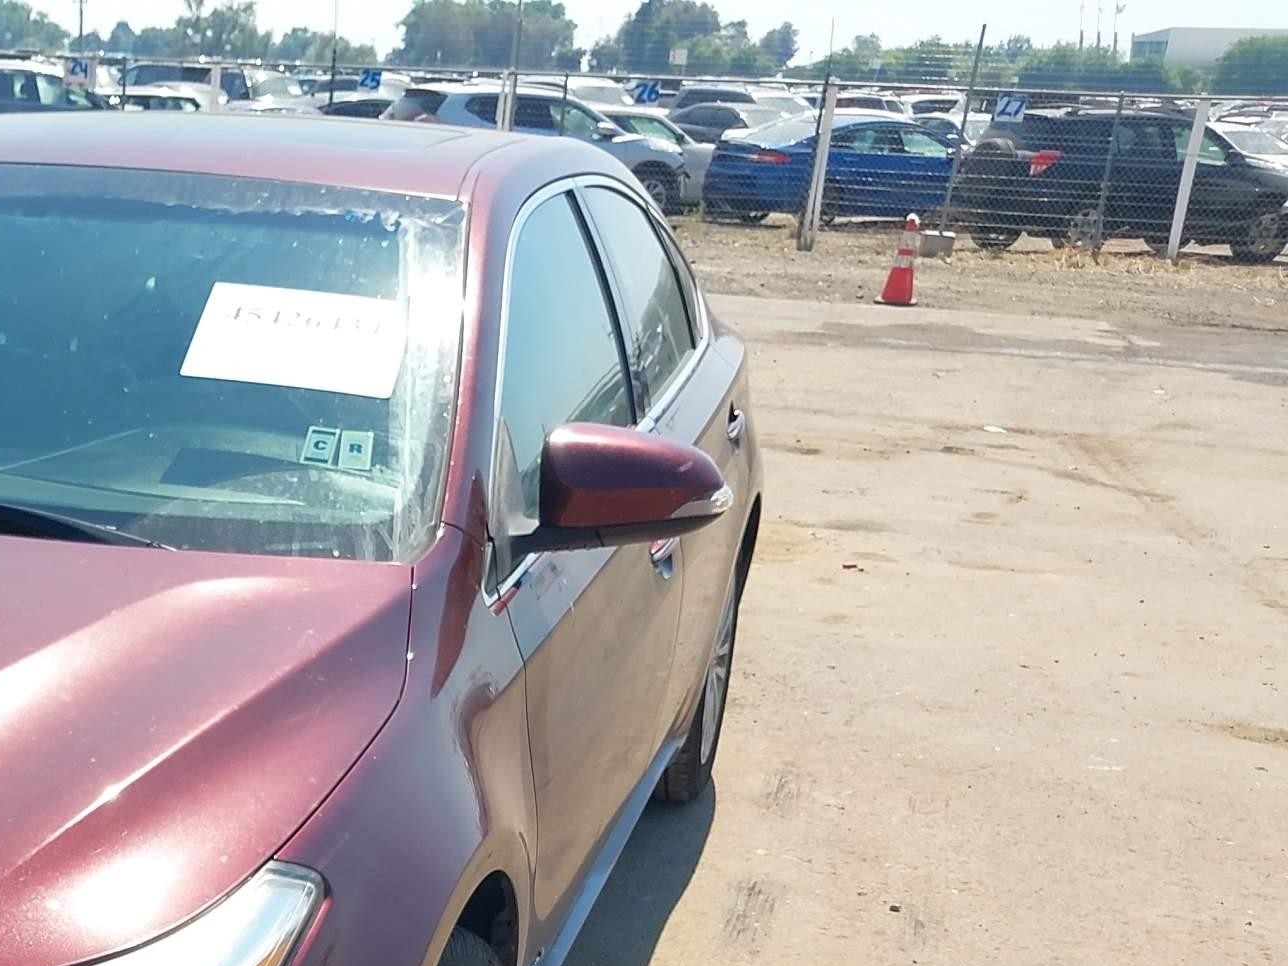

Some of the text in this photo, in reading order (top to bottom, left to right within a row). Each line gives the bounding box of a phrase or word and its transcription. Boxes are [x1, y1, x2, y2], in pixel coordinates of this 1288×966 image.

[71, 58, 88, 78] 24
[360, 68, 381, 89] 25
[633, 81, 660, 104] 26
[997, 94, 1025, 116] 27
[313, 439, 328, 451] C
[348, 442, 363, 454] R
